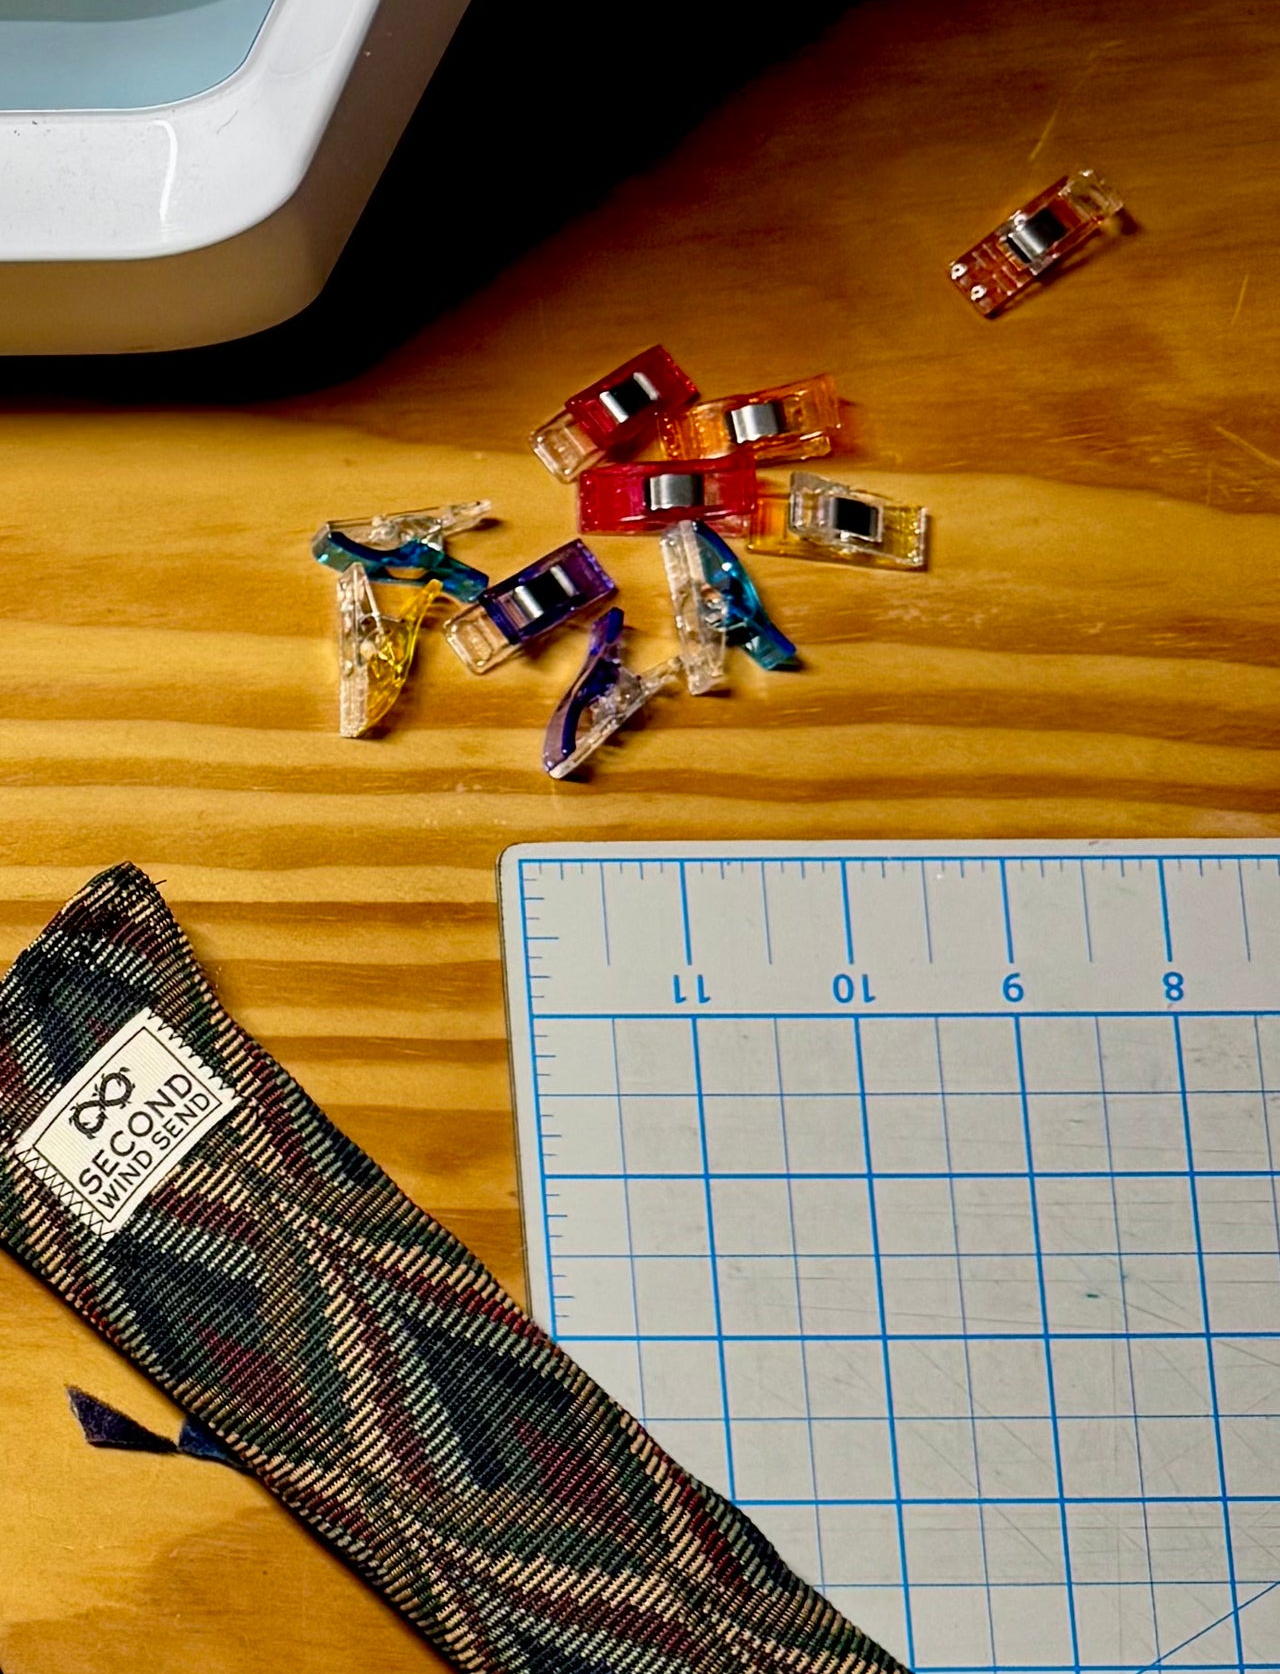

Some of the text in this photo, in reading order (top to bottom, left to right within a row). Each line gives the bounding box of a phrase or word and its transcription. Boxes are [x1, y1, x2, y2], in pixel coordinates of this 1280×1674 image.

[672, 970, 1185, 1005] 11 10 9 8
[79, 1074, 192, 1195] SECOND
[97, 1092, 210, 1211] WIND SEND
